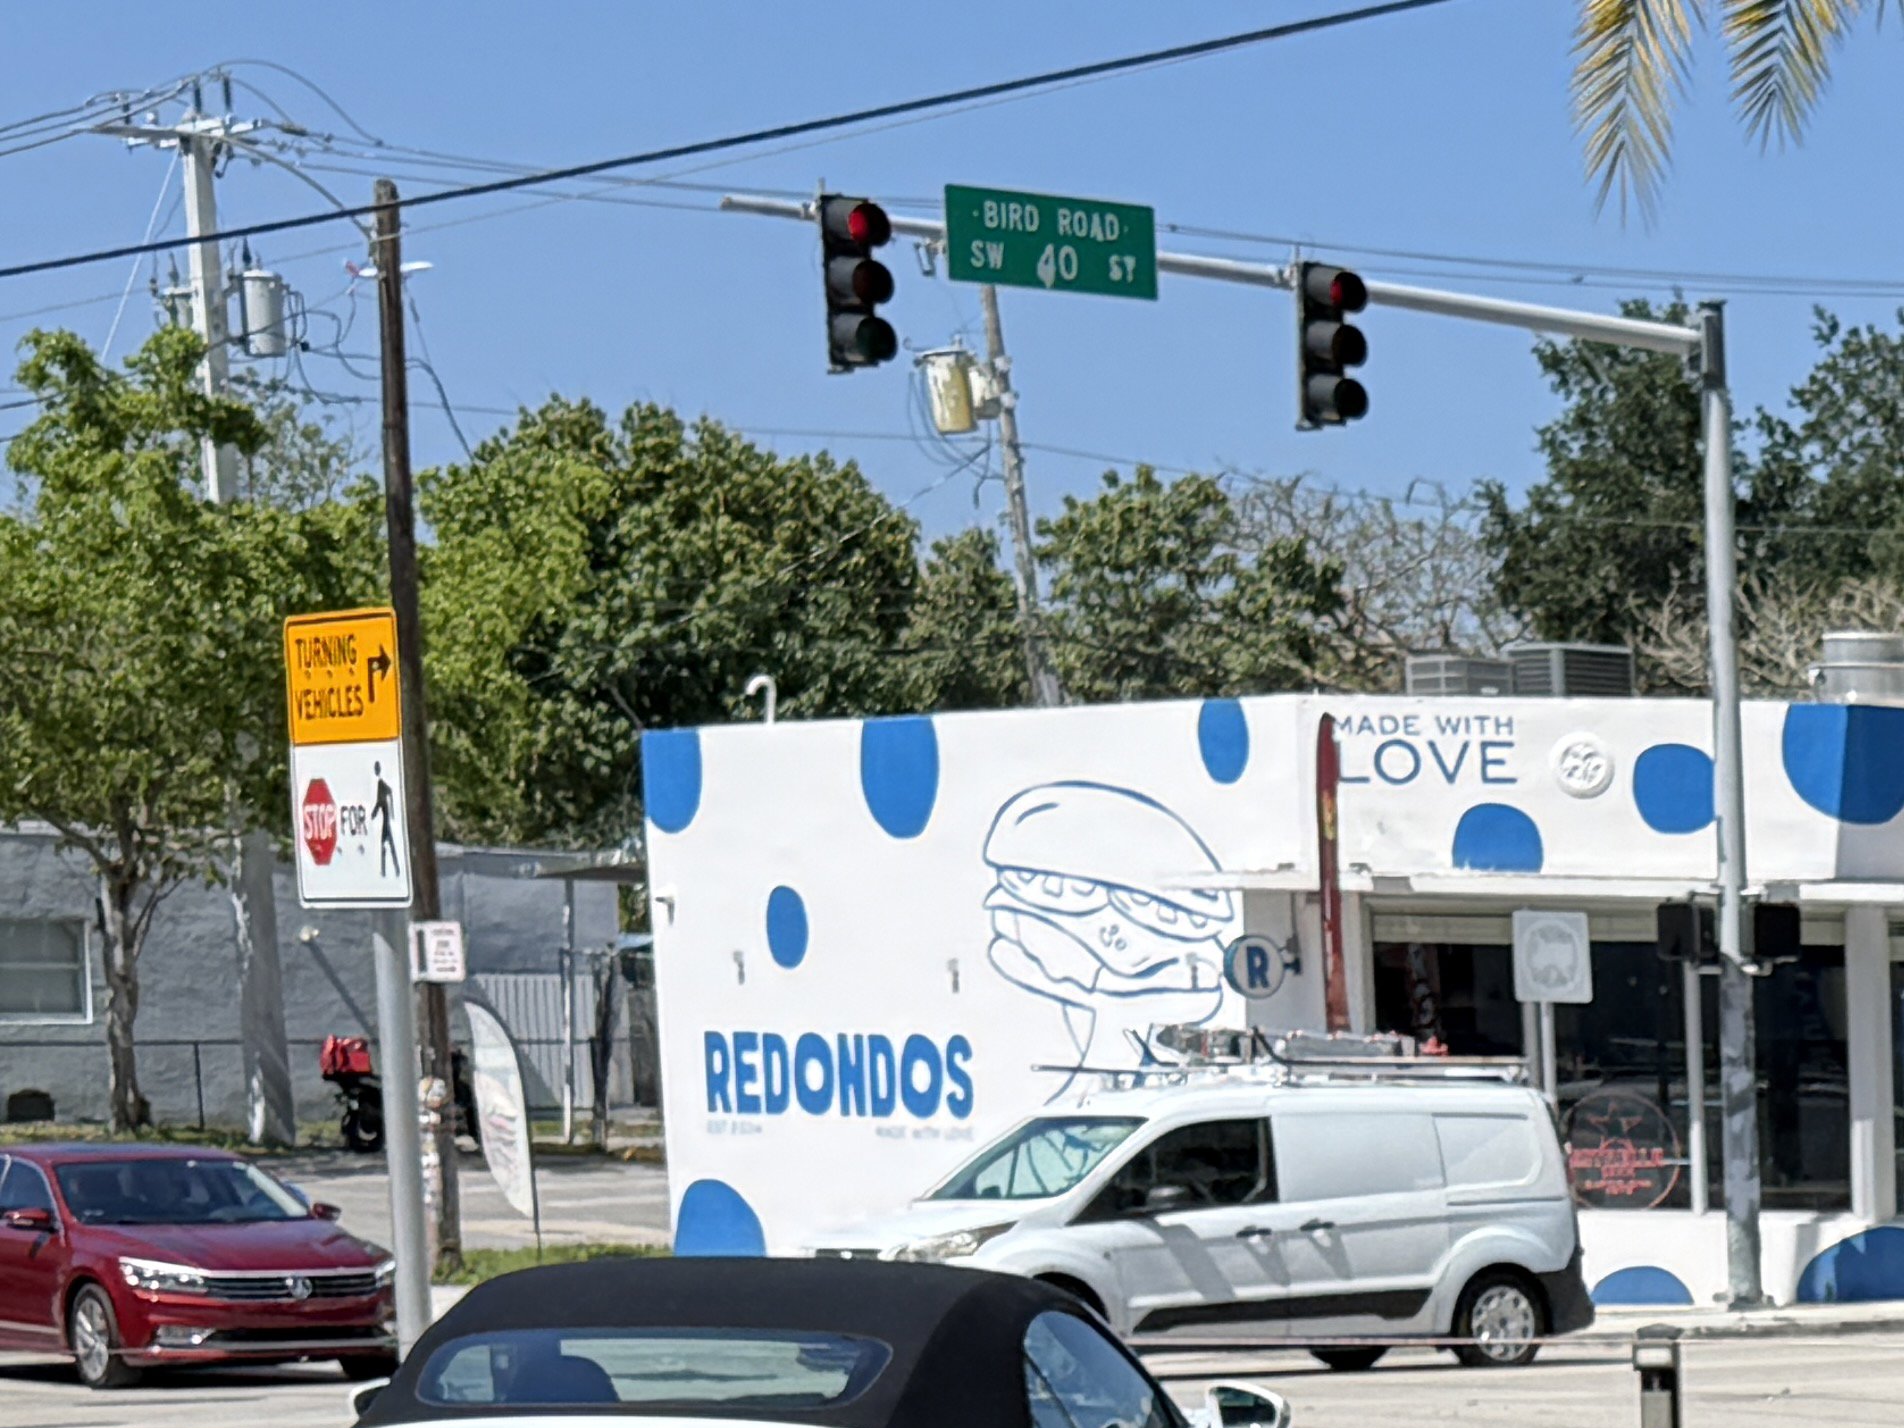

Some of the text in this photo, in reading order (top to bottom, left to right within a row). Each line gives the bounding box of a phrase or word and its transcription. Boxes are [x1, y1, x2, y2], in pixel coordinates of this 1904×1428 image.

[984, 199, 1120, 242] BIRD ROAD
[970, 240, 1136, 289] SW 40 ST
[295, 634, 357, 669] TURNING
[294, 684, 364, 720] VEHICLES
[1334, 715, 1514, 736] MADE WITH
[303, 804, 368, 840] STOP FOR
[1246, 946, 1270, 989] R
[704, 1030, 974, 1120] REDONDOS
